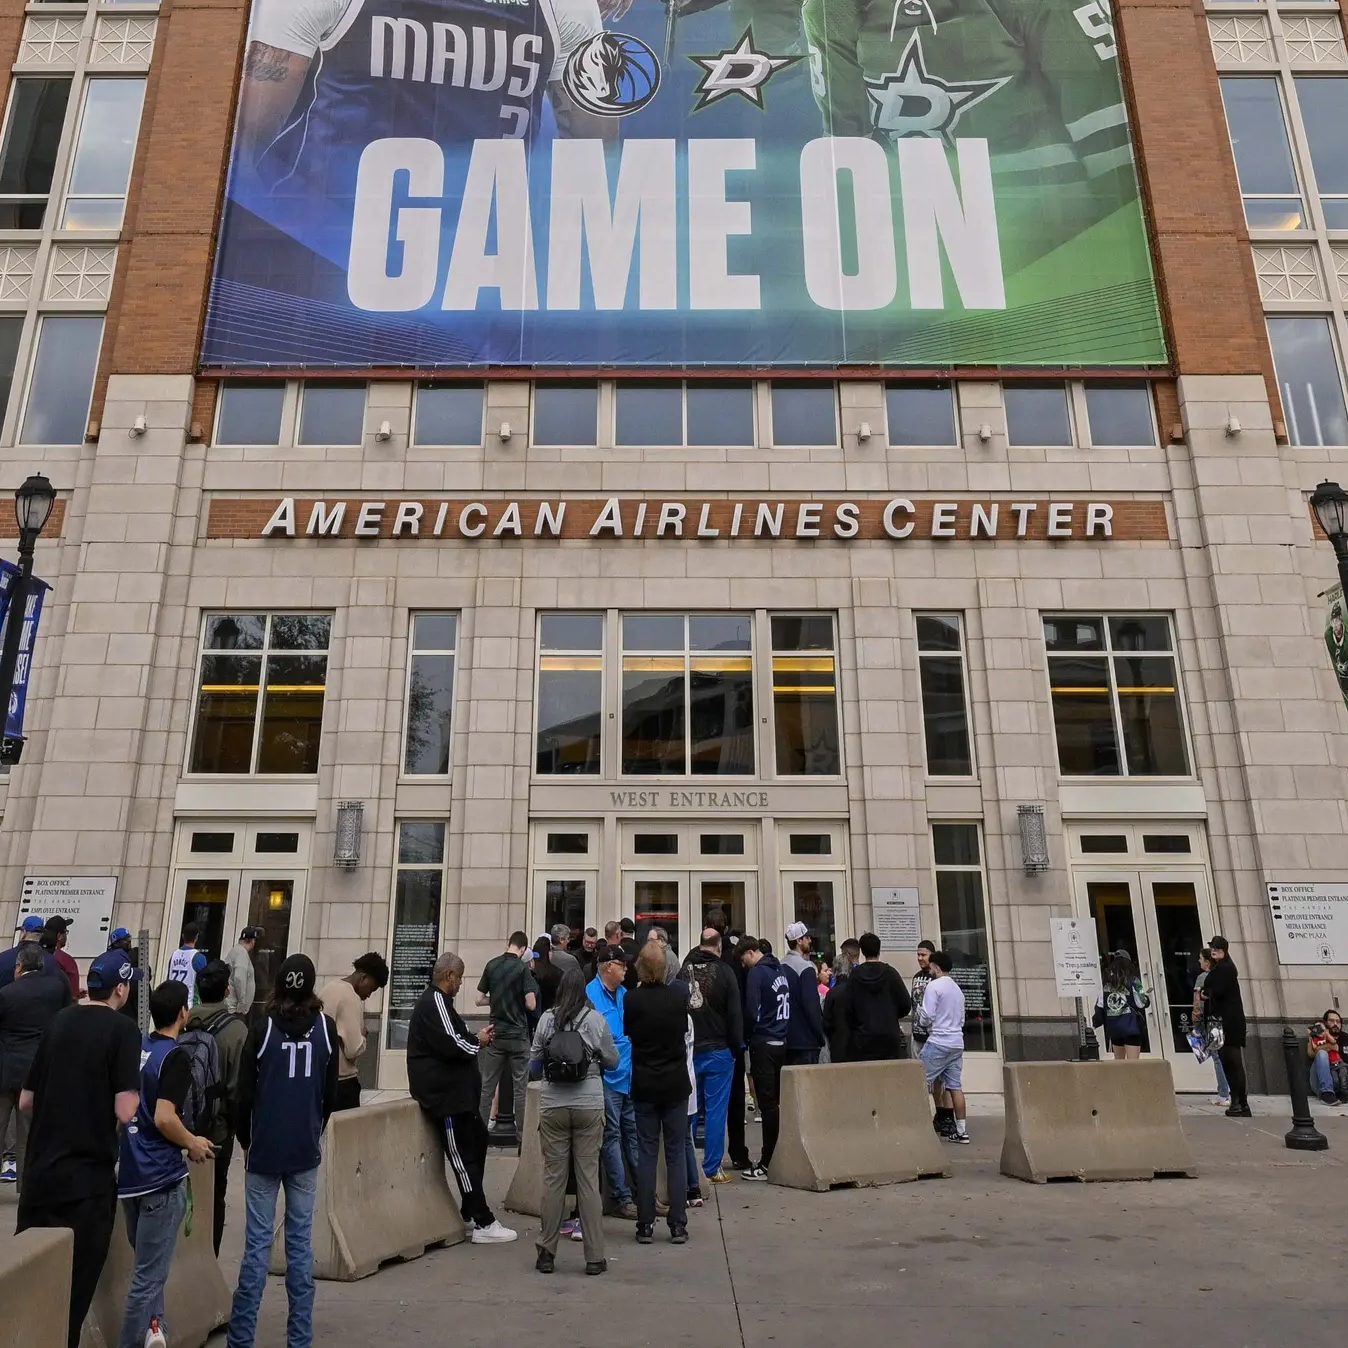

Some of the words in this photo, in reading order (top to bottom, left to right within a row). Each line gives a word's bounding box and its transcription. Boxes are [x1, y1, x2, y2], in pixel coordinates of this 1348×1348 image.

[370, 15, 543, 98] MAVS
[347, 137, 761, 312] GAME
[799, 136, 1007, 311] ON
[261, 497, 566, 537] AMERICAN
[589, 497, 860, 538] AIRLINES
[883, 498, 1115, 539] CENTER
[1327, 588, 1343, 606] HARLE
[610, 792, 660, 807] WEST
[669, 792, 769, 807] ENTRANCE
[172, 969, 188, 981] 77
[776, 992, 790, 1021] 26
[281, 1041, 313, 1078] 77
